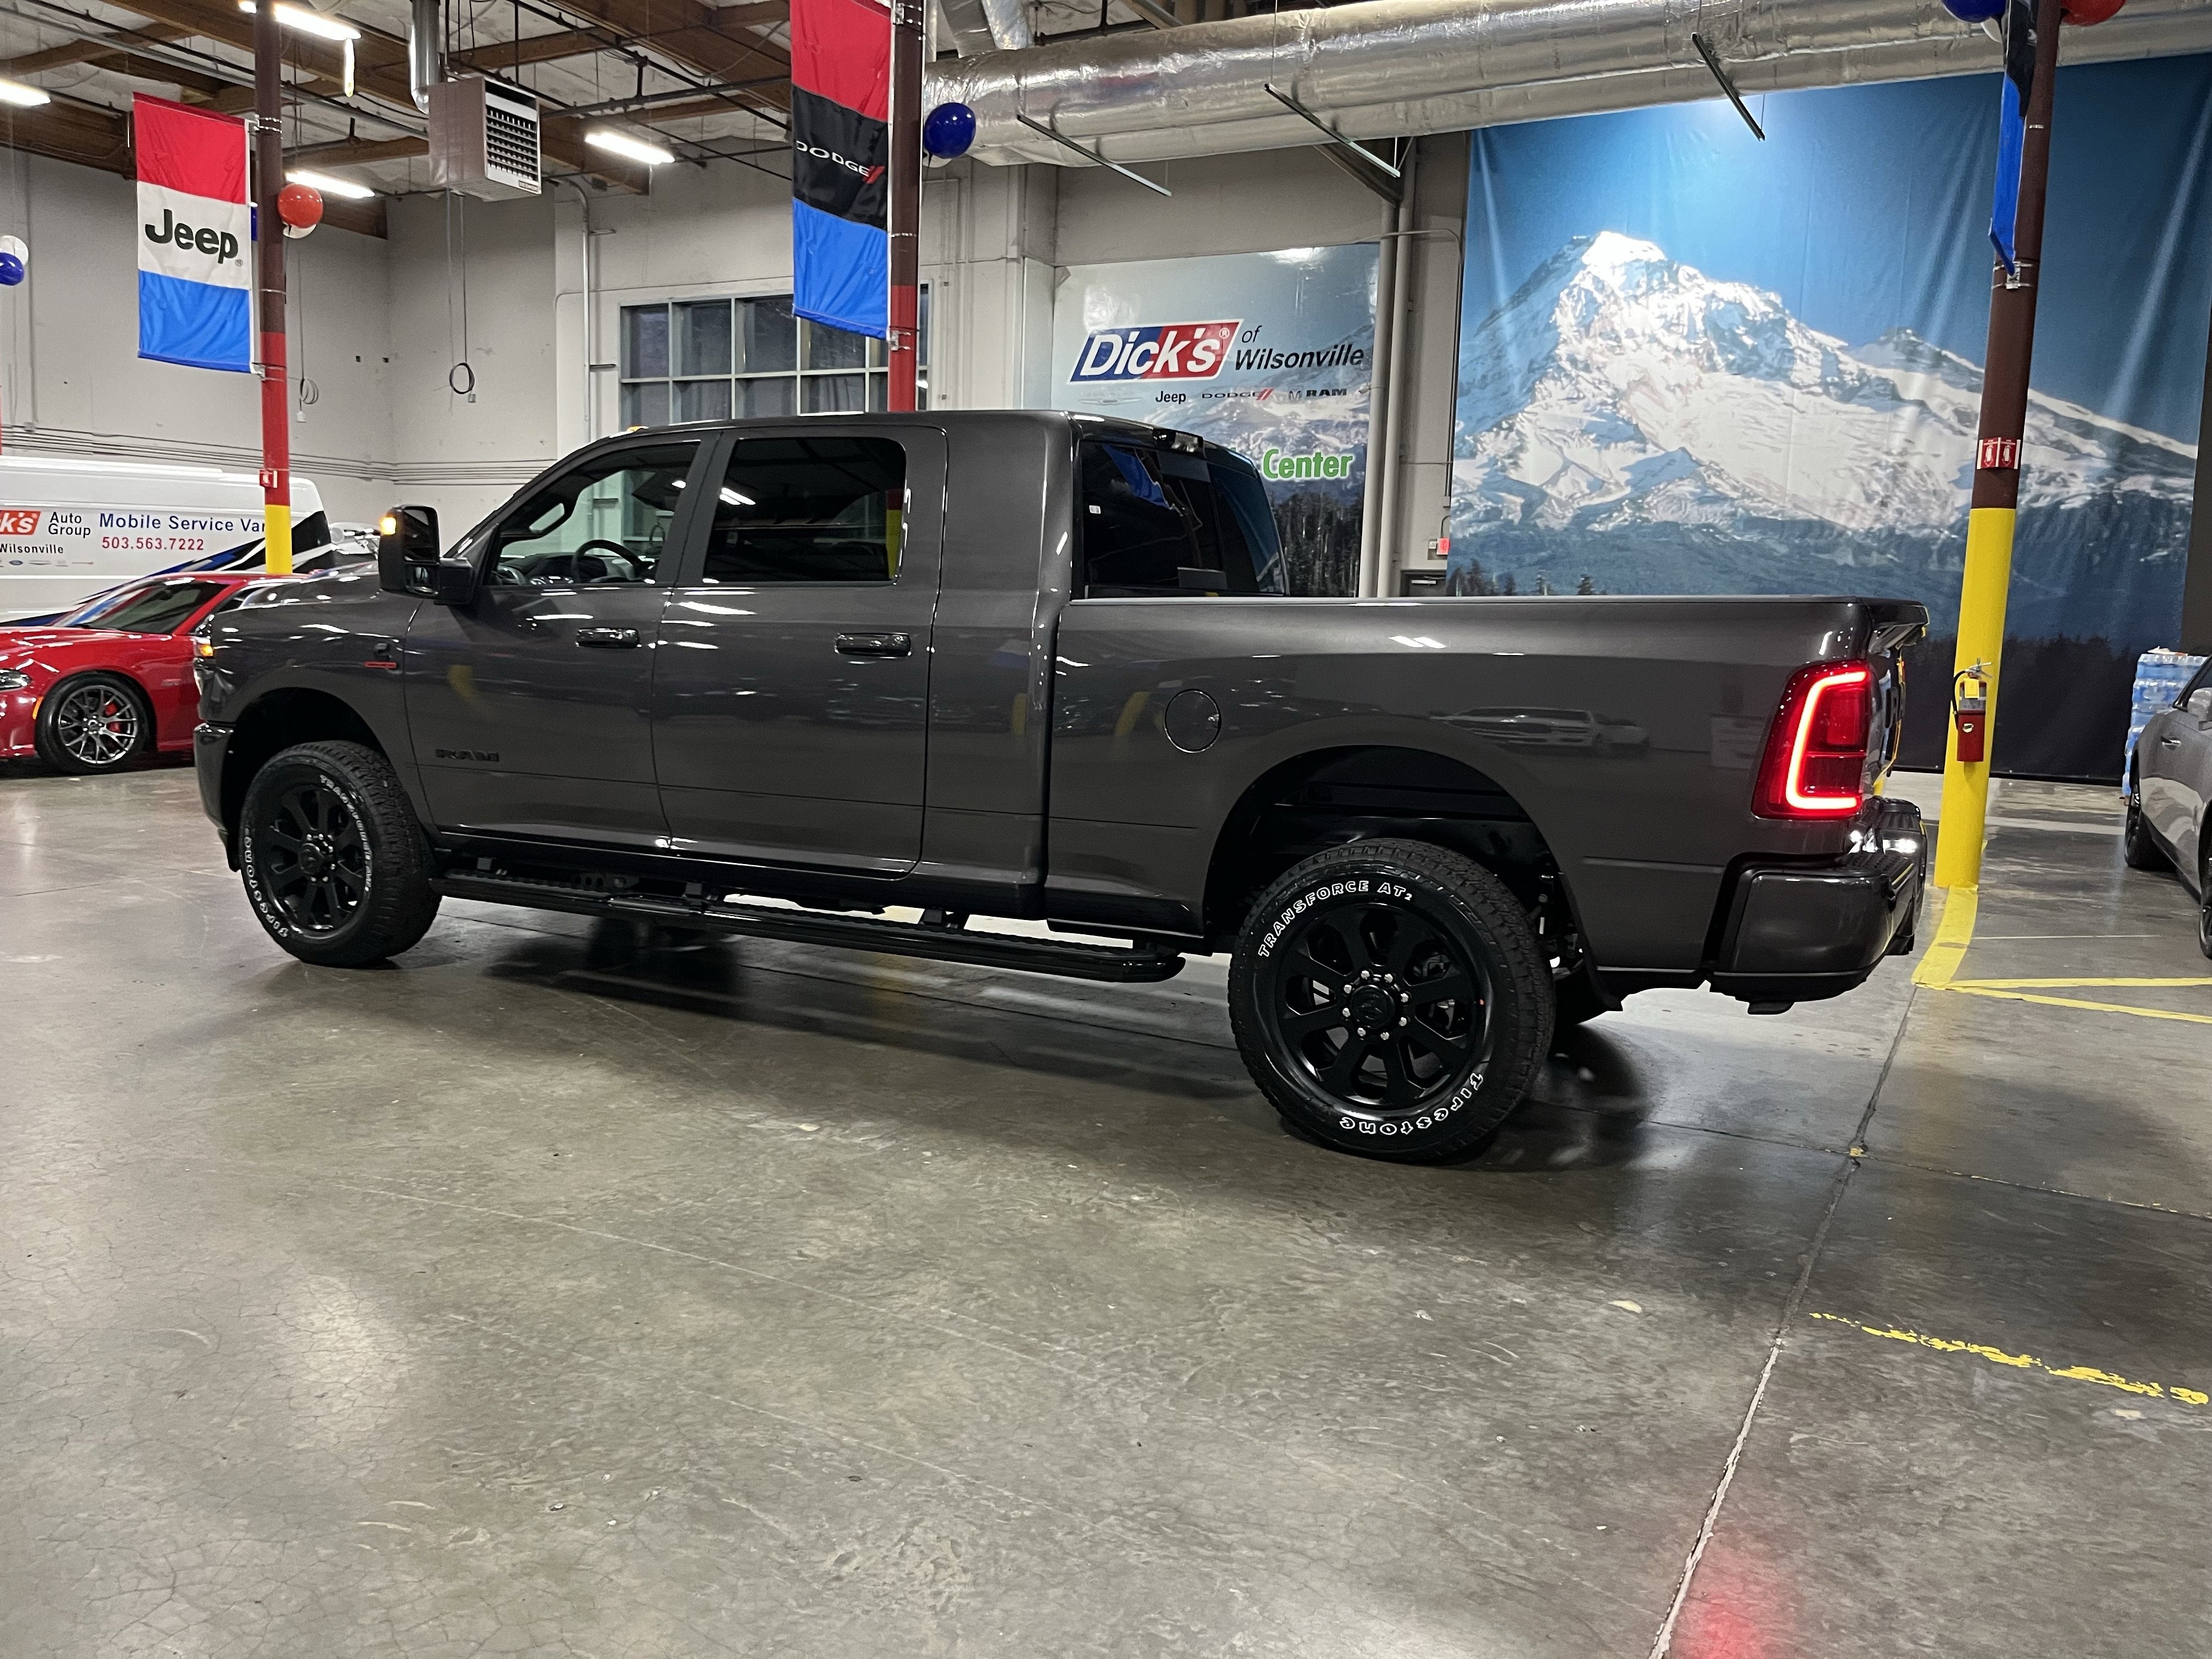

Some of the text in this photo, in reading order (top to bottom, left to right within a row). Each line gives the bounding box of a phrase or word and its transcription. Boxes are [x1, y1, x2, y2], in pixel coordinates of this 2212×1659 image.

[796, 140, 871, 177] DODGE
[145, 208, 238, 264] Jeep
[1242, 325, 1262, 343] of
[1079, 328, 1220, 376] Dick's
[1235, 343, 1364, 371] Wilsonville
[1155, 391, 1186, 404] Jeep
[1306, 388, 1347, 397] RAM
[1263, 449, 1353, 478] Center
[0, 512, 34, 533] k's
[50, 511, 82, 524] Auto
[99, 513, 161, 529] Mobile
[168, 516, 234, 531] Service
[48, 523, 91, 538] Group
[102, 537, 204, 551] 503.563.7222
[435, 748, 500, 762] RAM
[1258, 881, 1369, 957] TRANSFORCE
[1339, 1073, 1483, 1135] Firestone
